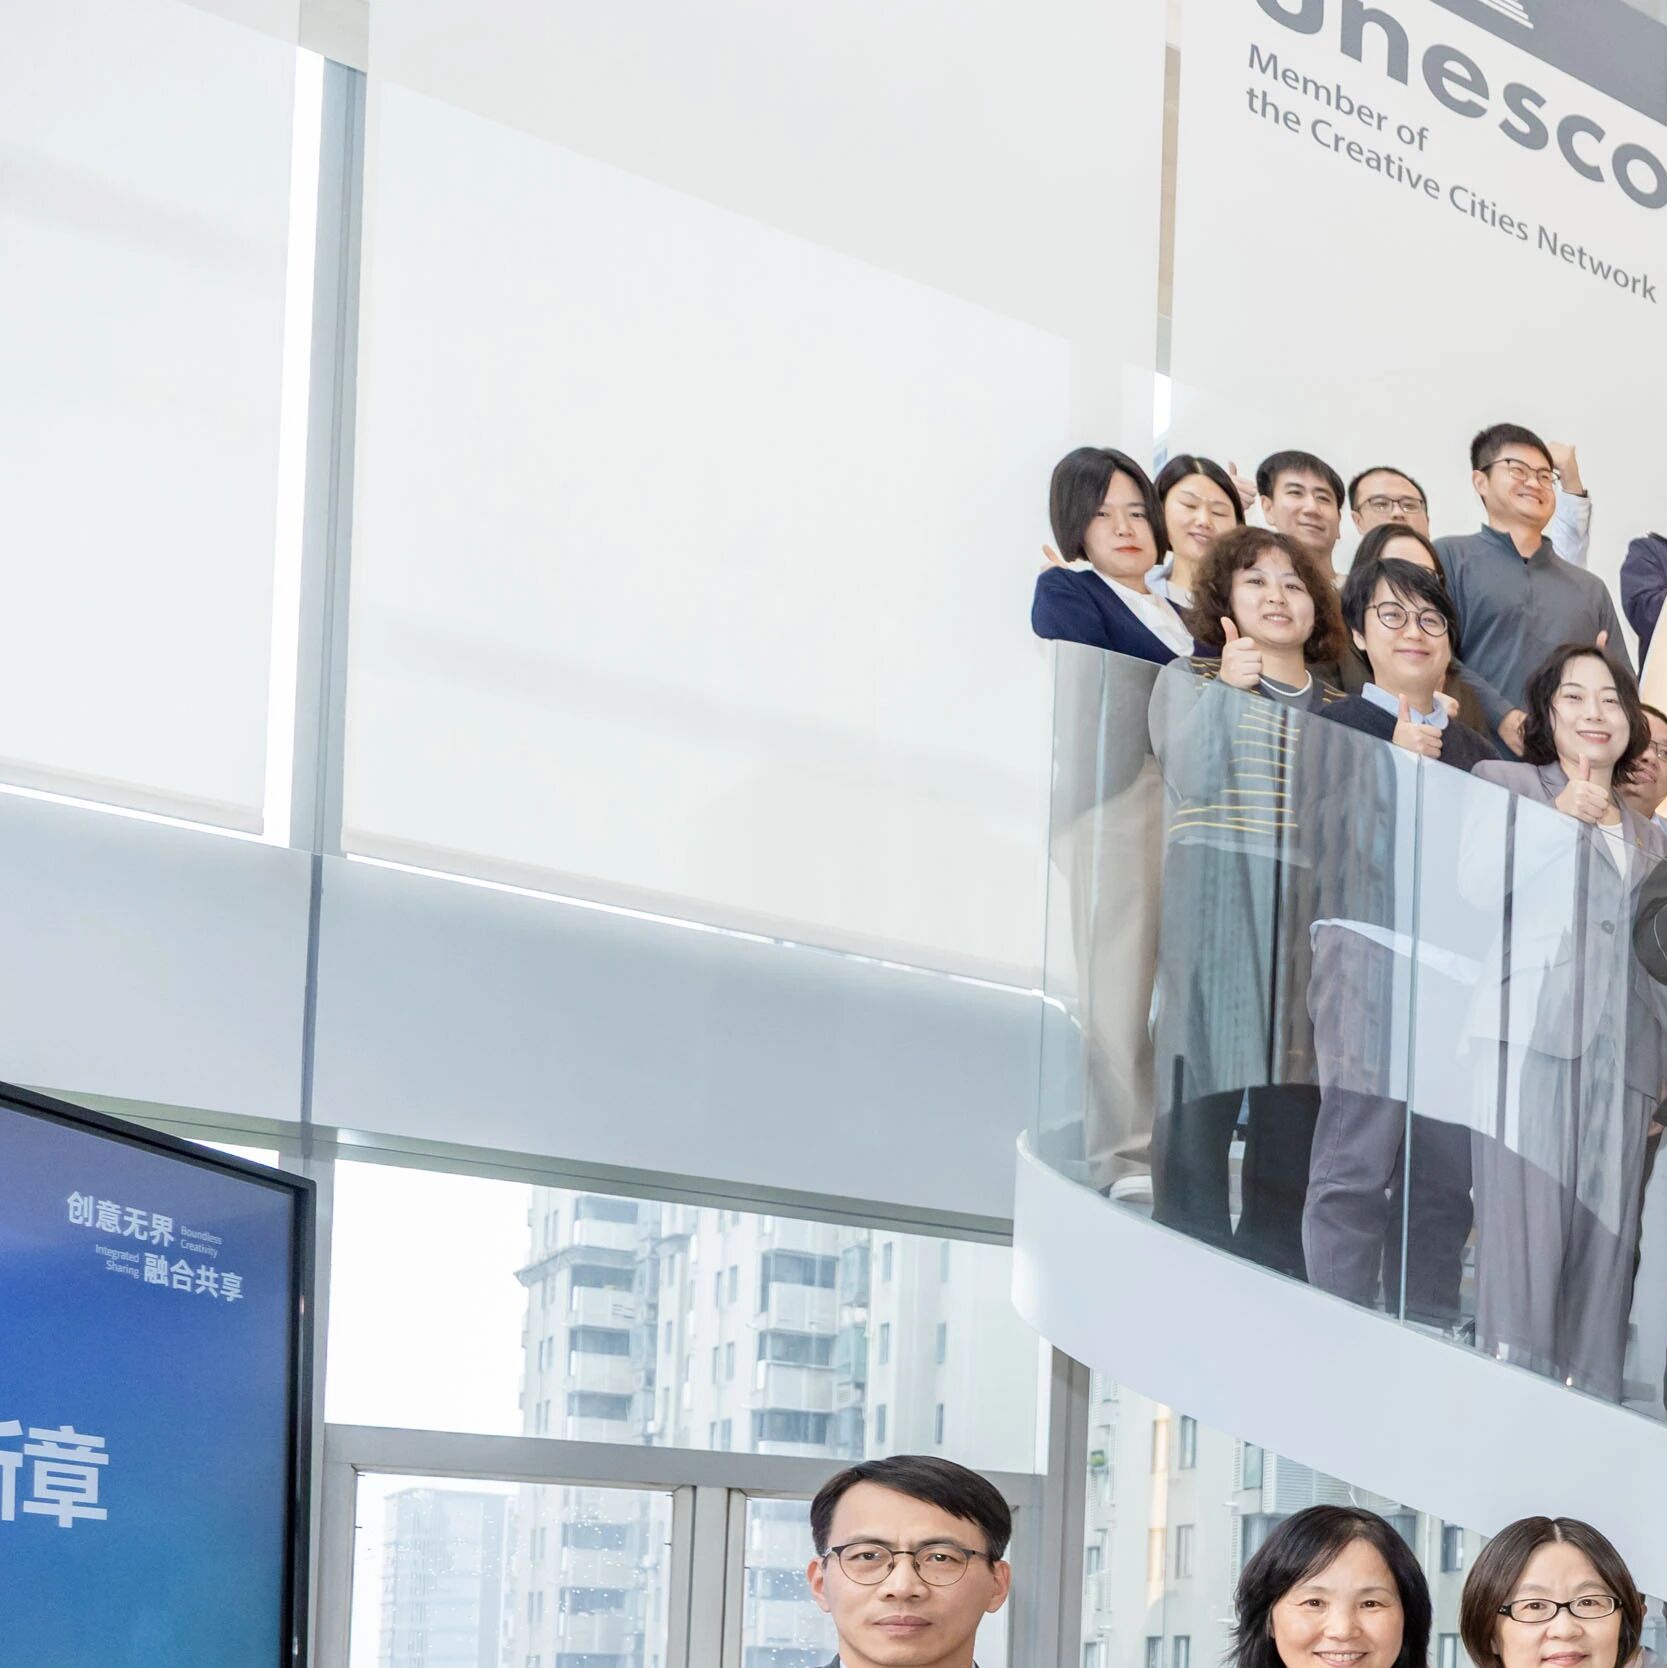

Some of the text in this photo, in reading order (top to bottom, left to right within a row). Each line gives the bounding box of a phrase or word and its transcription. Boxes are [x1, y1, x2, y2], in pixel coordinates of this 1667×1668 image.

[1248, 43, 1430, 153] Member of
[1246, 87, 1657, 304] the Creative Cities Network
[66, 1190, 175, 1248] 创意无界
[181, 1225, 224, 1245] Boundless
[95, 1244, 140, 1264] Integrated
[180, 1238, 219, 1259] Creativity
[105, 1260, 140, 1279] Sharing
[143, 1252, 244, 1302] 融合共享
